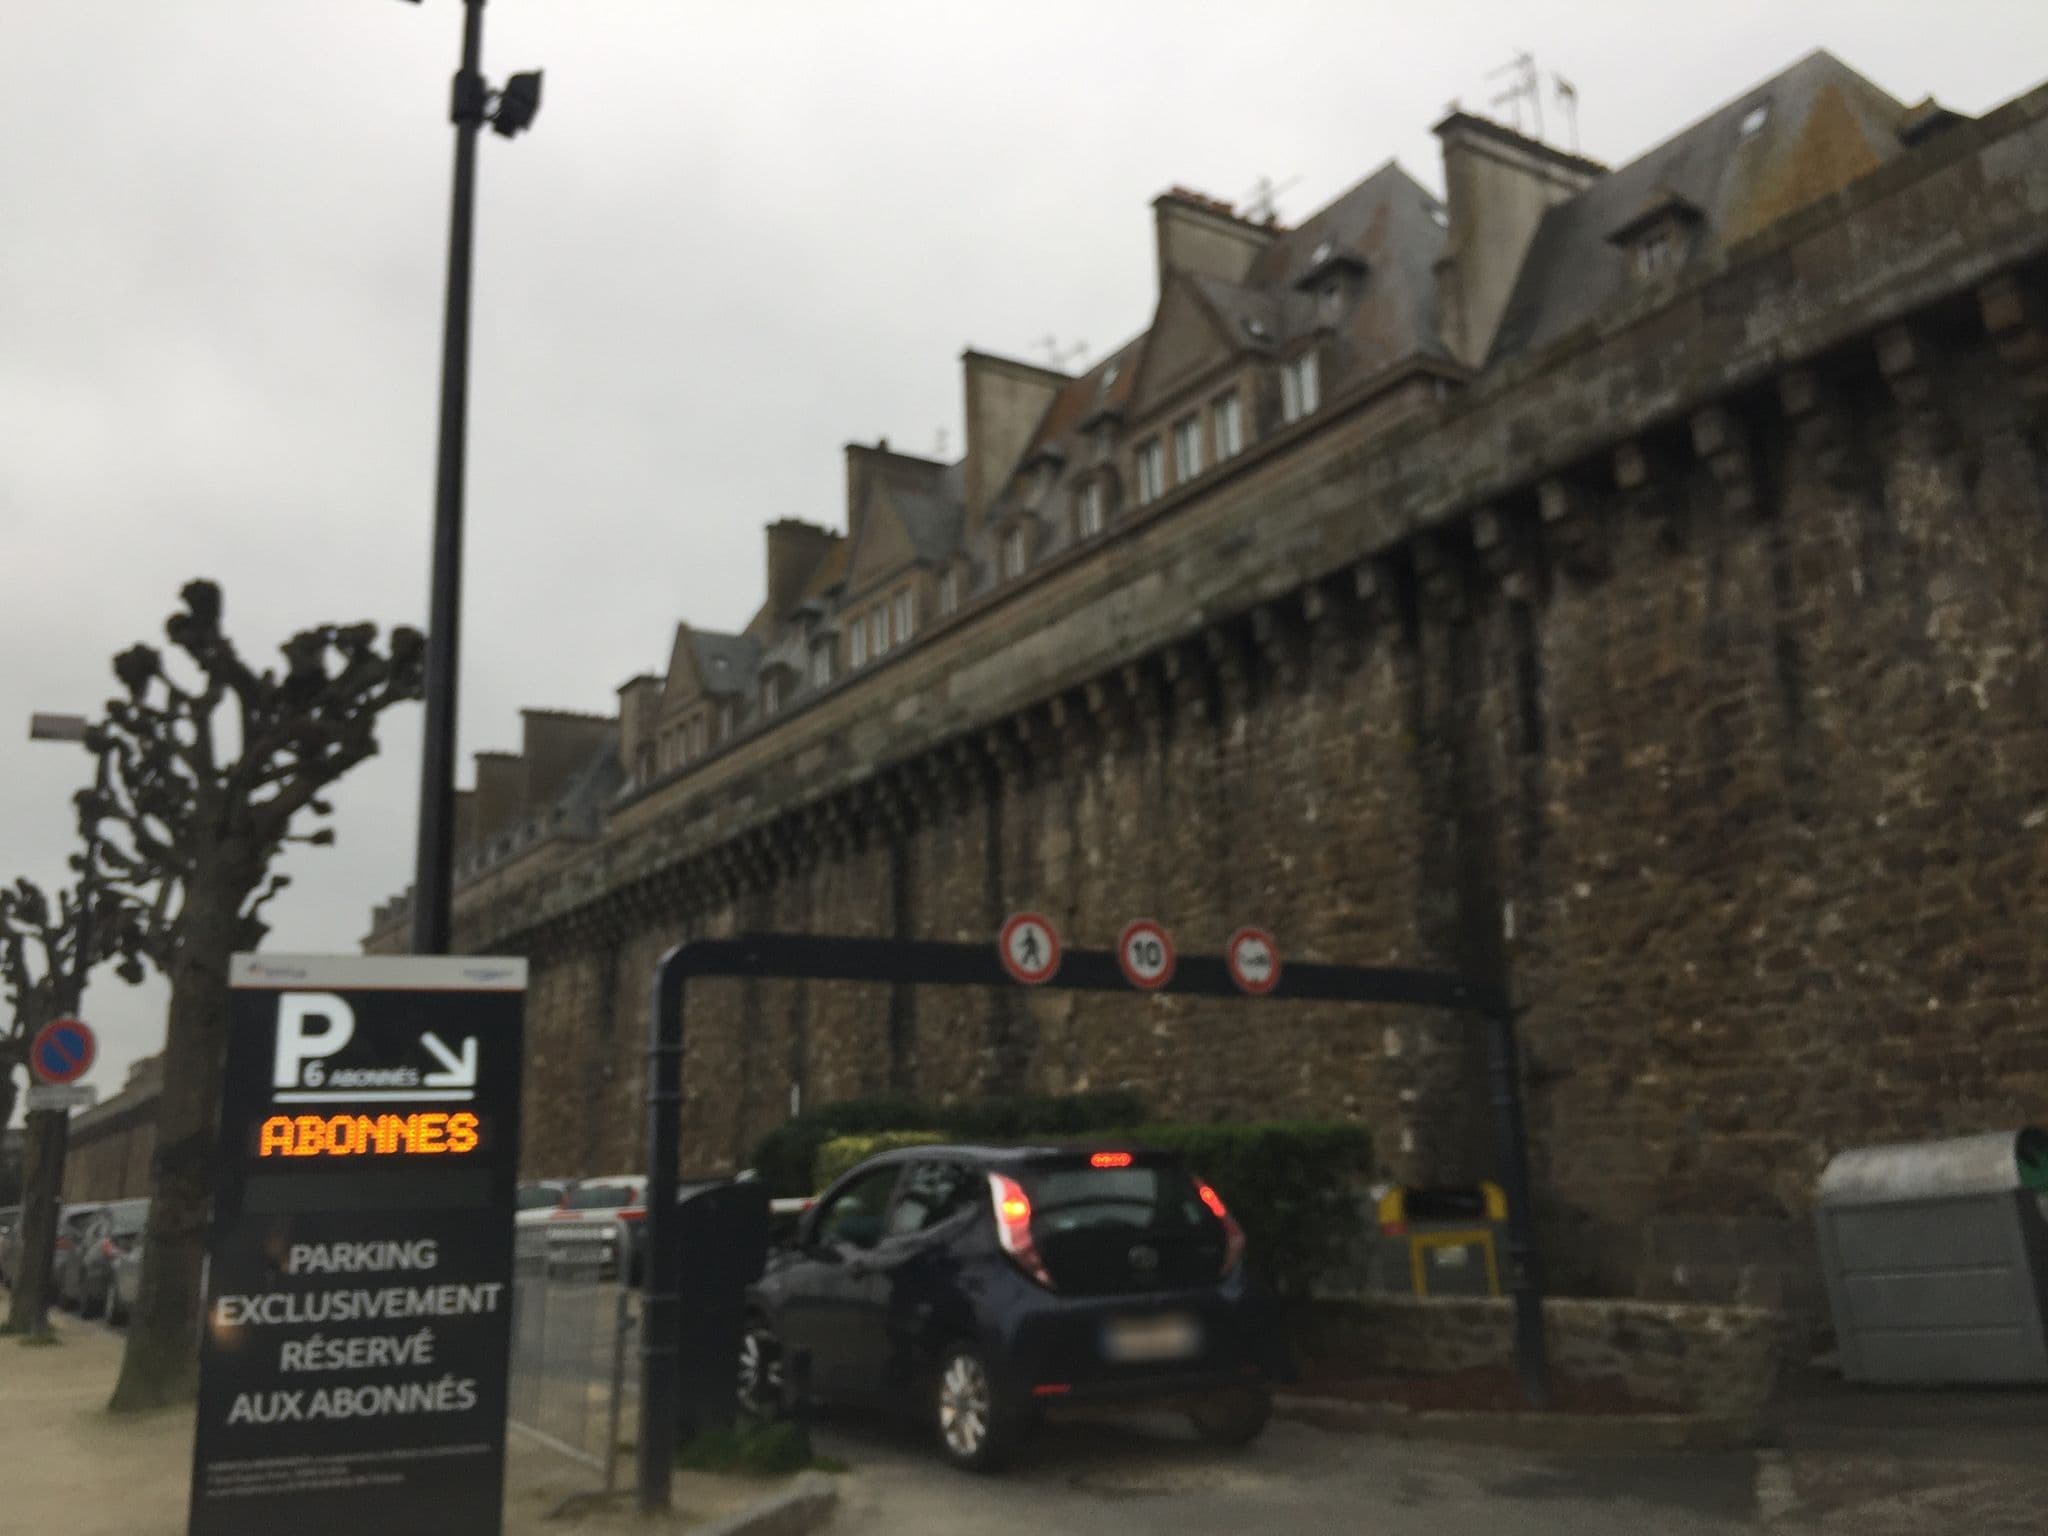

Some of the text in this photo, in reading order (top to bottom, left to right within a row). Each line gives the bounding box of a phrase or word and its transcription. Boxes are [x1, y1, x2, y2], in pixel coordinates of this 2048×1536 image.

[1133, 941, 1161, 966] 10
[273, 992, 356, 1088] P
[303, 1060, 325, 1087] 6
[260, 1113, 479, 1156] ABONNES
[289, 1240, 437, 1273] PARKING
[217, 1284, 502, 1325] EXCLUSIVEMENT
[281, 1328, 434, 1371] RÉSERVÉ
[229, 1374, 477, 1422] AUX ABONNÉS
